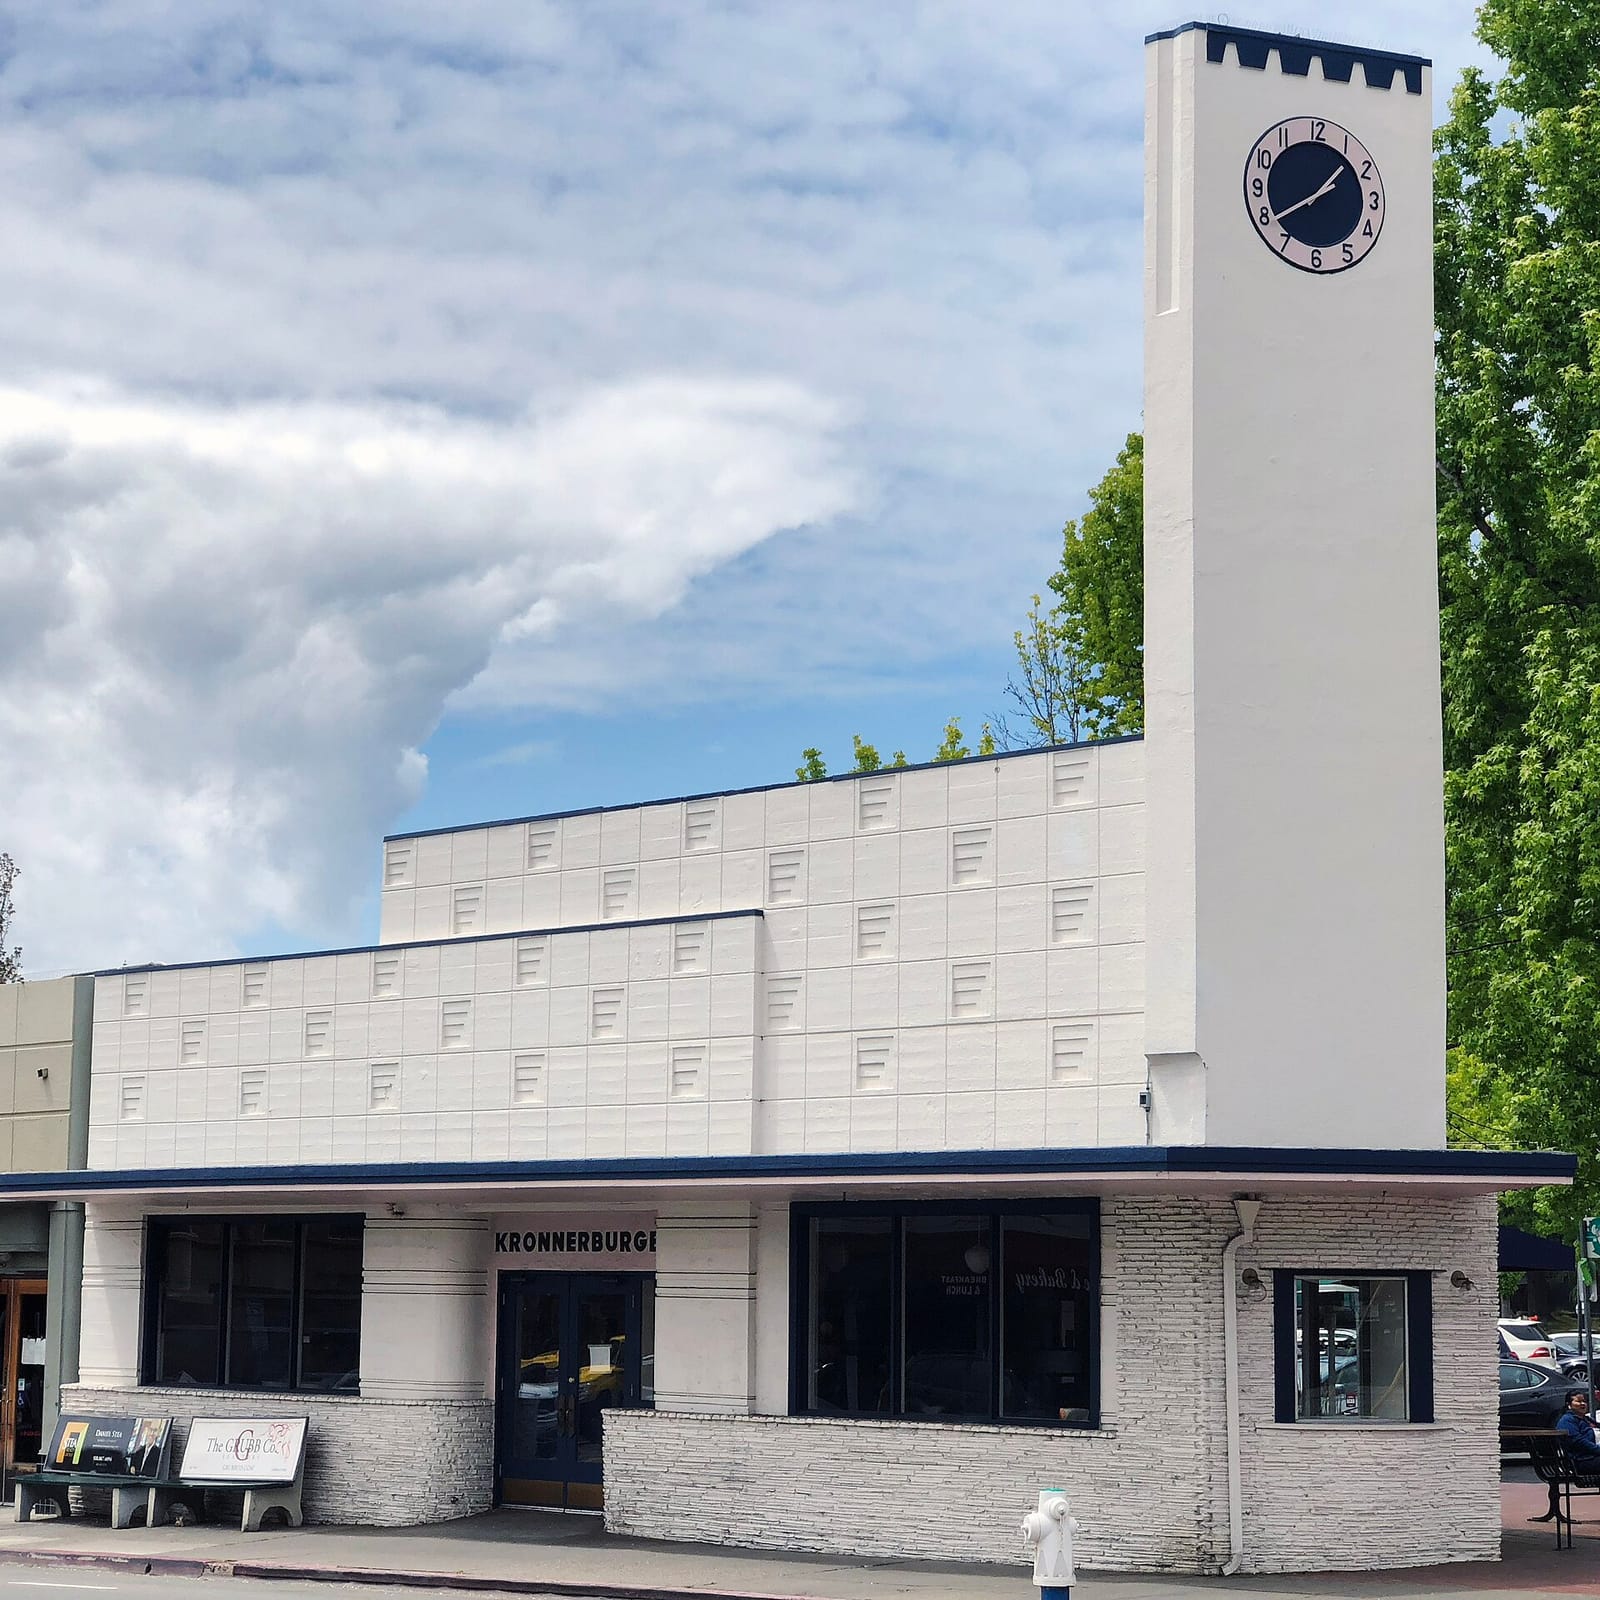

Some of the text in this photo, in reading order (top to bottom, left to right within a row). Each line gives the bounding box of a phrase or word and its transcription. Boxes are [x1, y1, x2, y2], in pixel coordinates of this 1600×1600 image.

[1279, 127, 1288, 148] 11
[1310, 120, 1326, 141] 12
[1344, 134, 1348, 154] 1
[1258, 148, 1271, 170] 10
[1360, 160, 1372, 180] 2
[1252, 178, 1263, 198] 9
[1369, 191, 1380, 210] 3
[1260, 206, 1270, 226] 8
[1362, 218, 1373, 238] 4
[1280, 232, 1290, 252] 7
[1311, 249, 1322, 268] 6
[1342, 244, 1353, 263] 5
[207, 1438, 223, 1453] The
